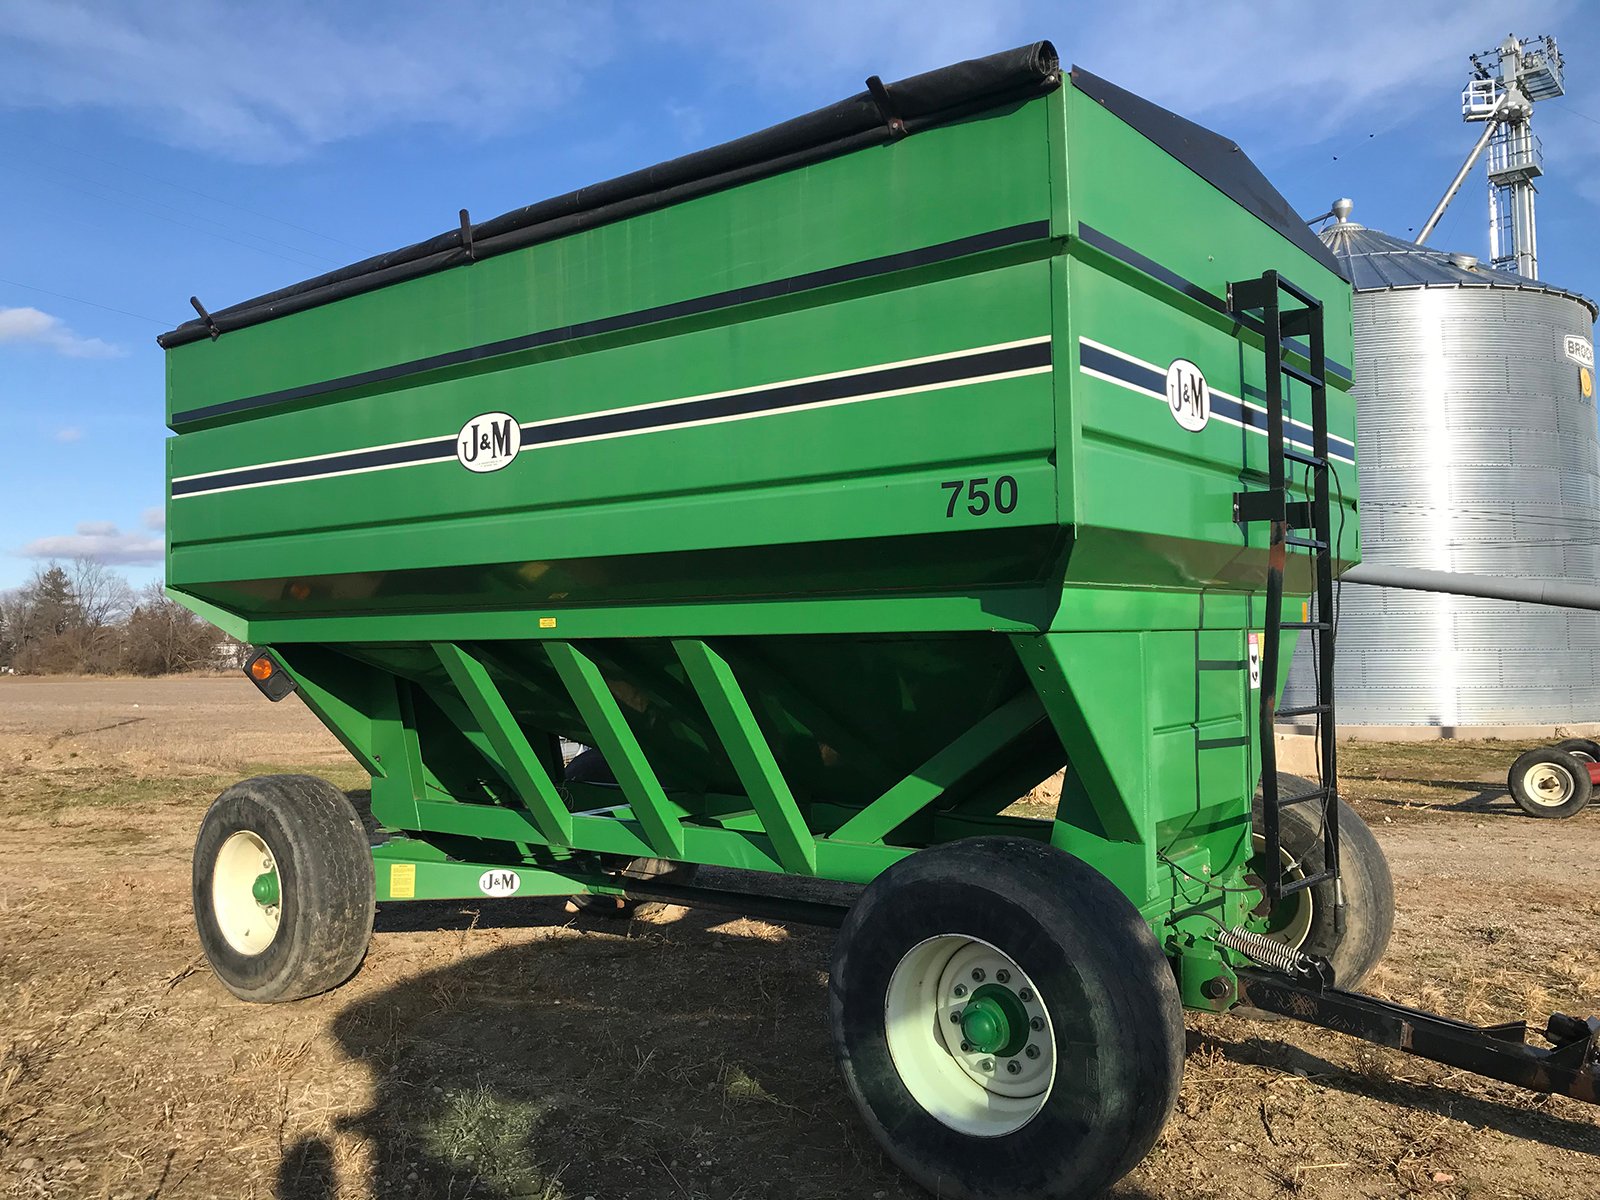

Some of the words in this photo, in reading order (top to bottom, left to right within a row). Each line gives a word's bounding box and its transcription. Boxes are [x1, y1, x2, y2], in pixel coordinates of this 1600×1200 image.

[1170, 367, 1205, 420] J&M
[462, 418, 512, 462] J&M
[941, 475, 1018, 518] 750
[483, 873, 514, 890] J&M
